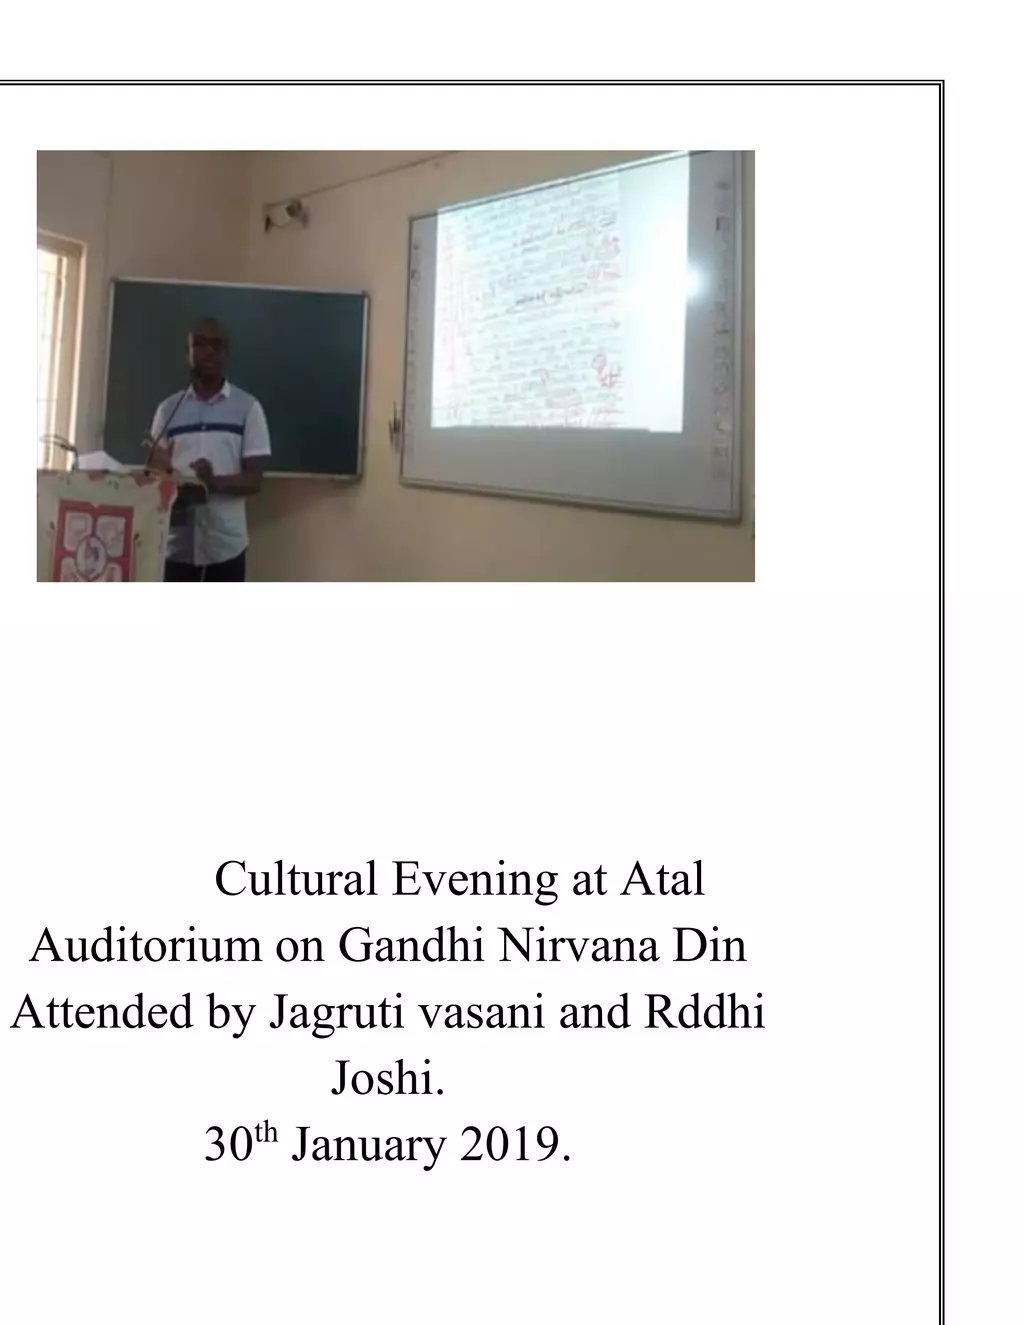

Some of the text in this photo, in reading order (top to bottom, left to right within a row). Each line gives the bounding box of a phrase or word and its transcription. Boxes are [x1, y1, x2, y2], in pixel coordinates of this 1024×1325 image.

[216, 860, 704, 906] Cultural Evening at Atal
[29, 926, 747, 962] Auditorium on Gandhi Nirvana Din
[10, 993, 765, 1038] Attended by Jagruti vasani and Rddhi
[331, 1059, 444, 1095] Joshi.
[206, 1120, 570, 1171] 30th January 2019.
